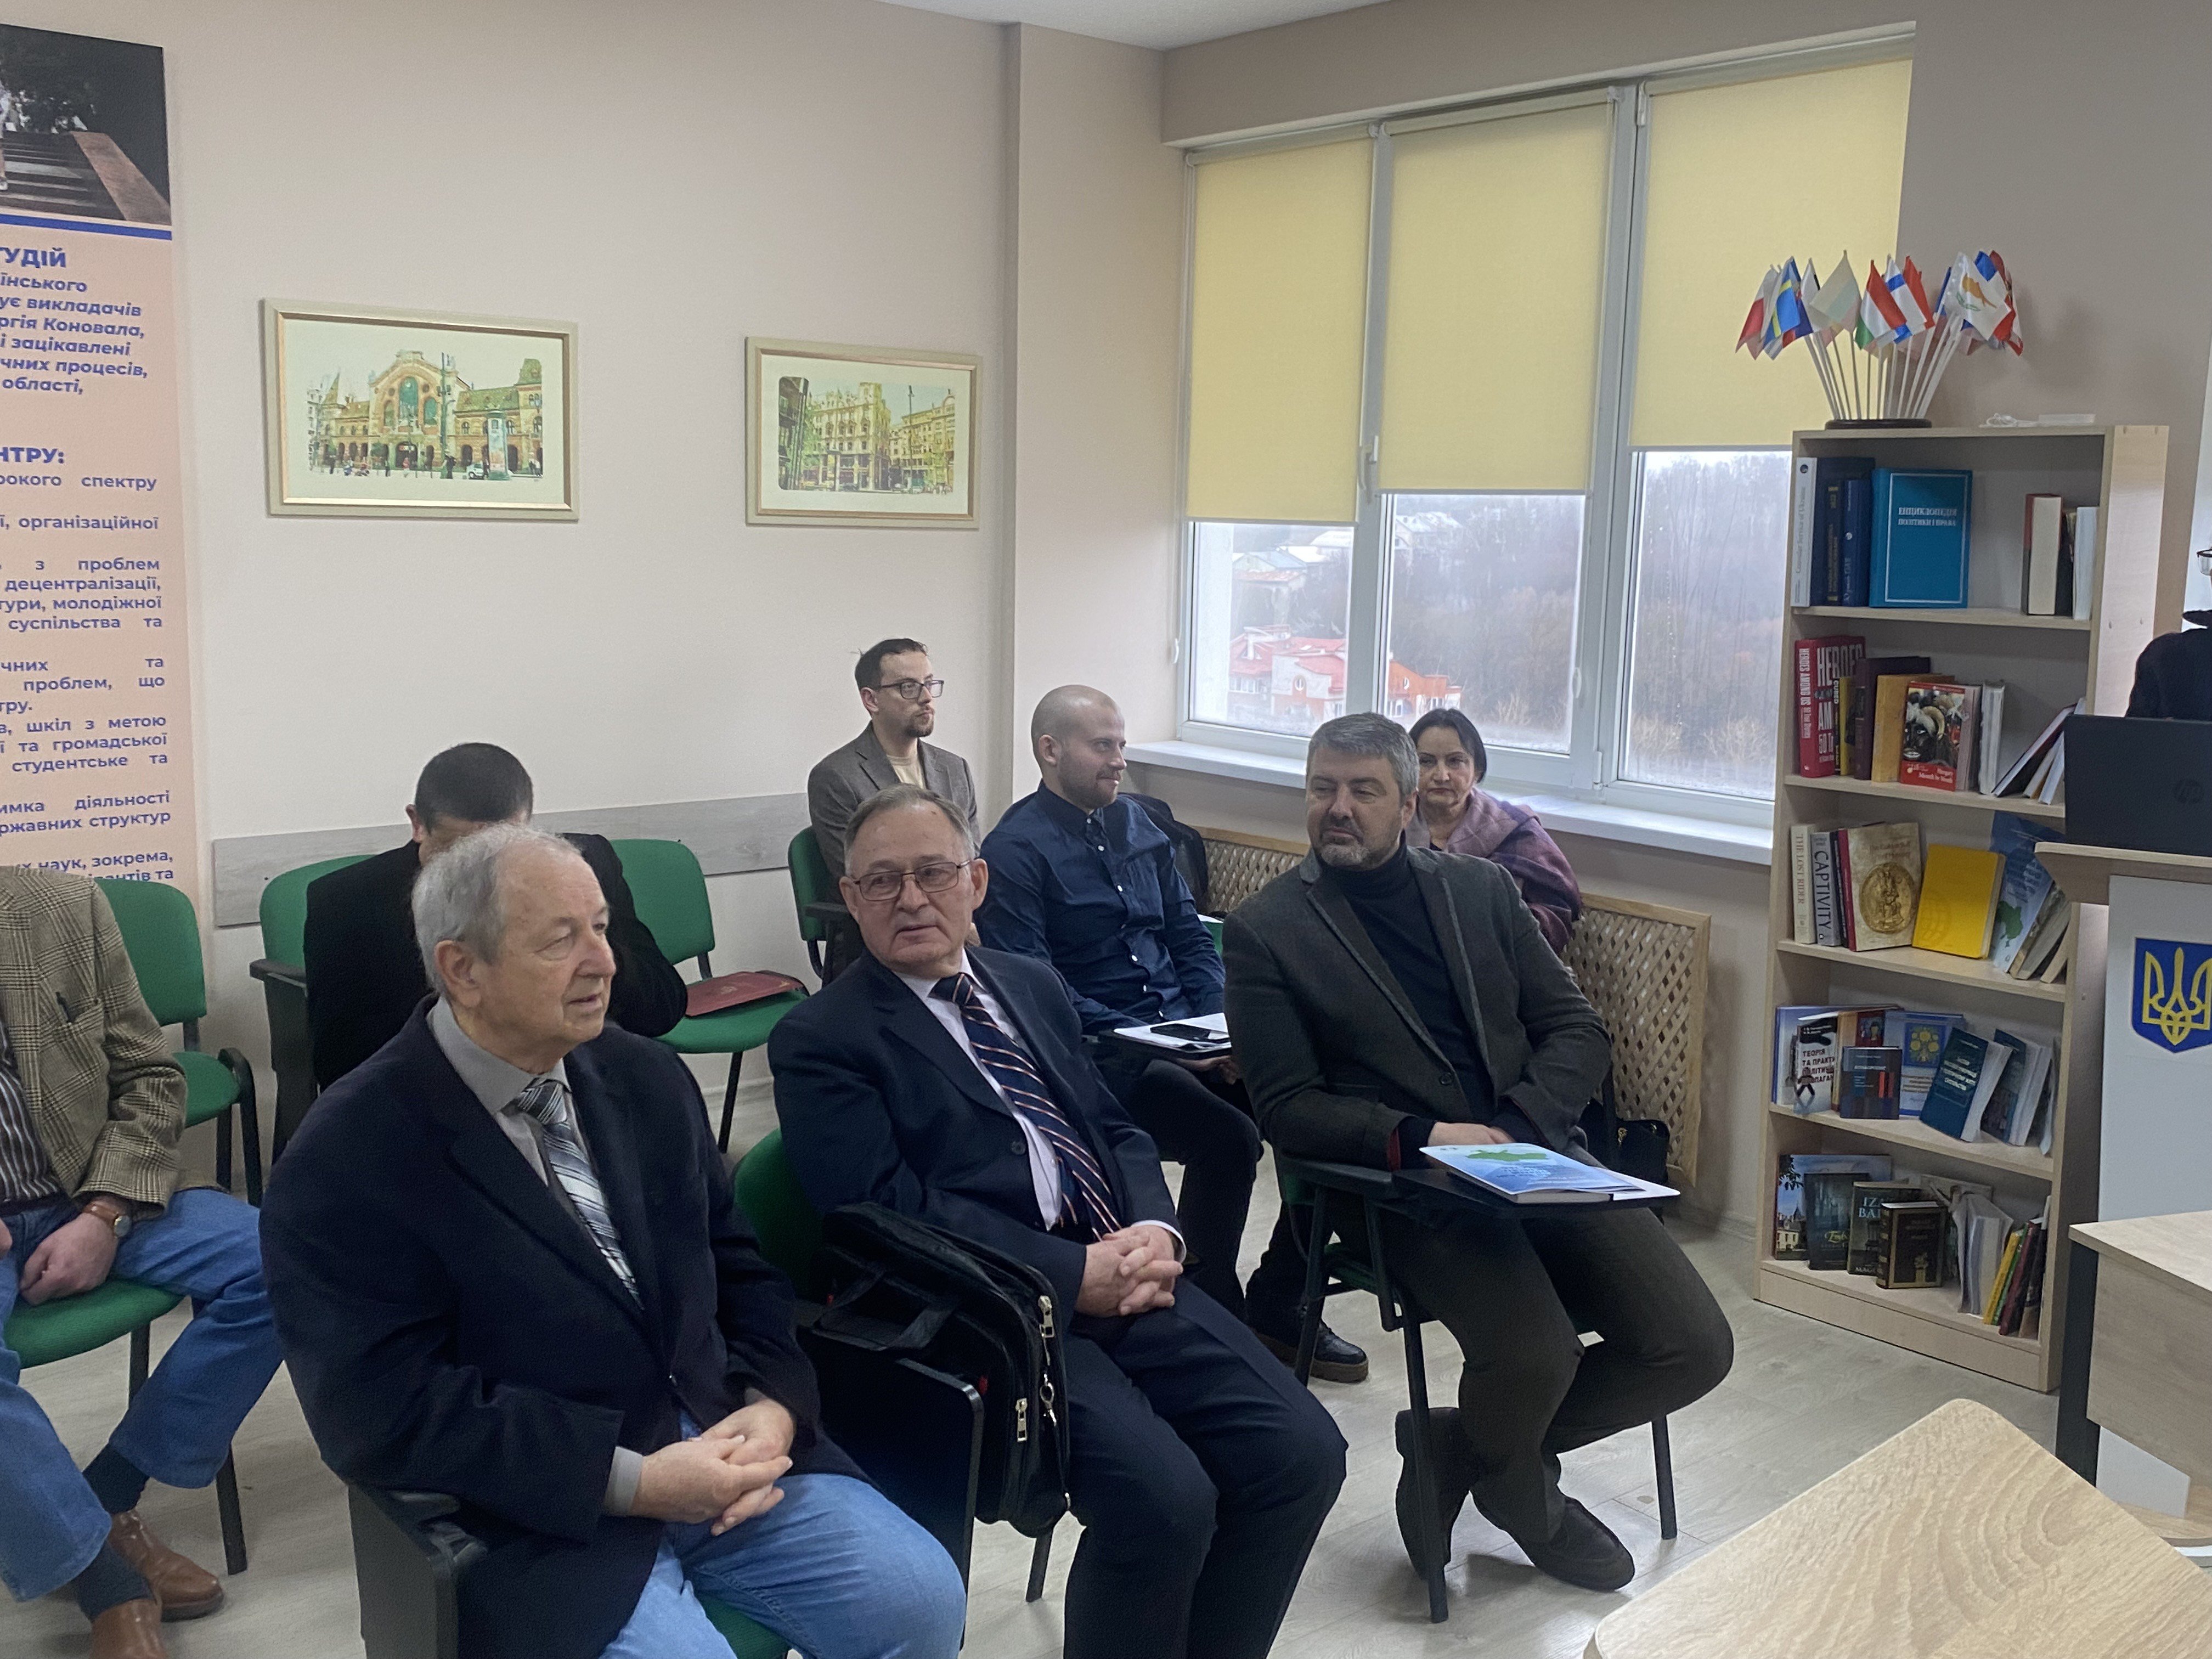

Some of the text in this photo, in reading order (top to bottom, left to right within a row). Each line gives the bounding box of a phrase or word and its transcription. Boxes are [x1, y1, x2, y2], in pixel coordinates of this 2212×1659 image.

[0, 272, 87, 292] їнського
[27, 298, 142, 316] викладачів
[43, 318, 144, 339] Коновала,
[11, 337, 131, 356] зацікавлені
[0, 359, 148, 378] чних процесів,
[2, 377, 83, 395] області,
[81, 477, 157, 491] спектру
[19, 515, 159, 531] організаційної
[36, 557, 160, 573] з проблем
[4, 576, 161, 592] децентралізації,
[53, 596, 161, 611] молодіжної
[8, 616, 162, 633] суспільства та
[1, 658, 163, 672] чних та
[1799, 648, 1810, 672] HEROES
[24, 676, 165, 693] проблем, що
[1799, 673, 1811, 696] AMONG
[1800, 696, 1812, 706] US
[27, 718, 71, 732] шкіл
[85, 720, 95, 730] з
[109, 717, 166, 728] метою
[18, 742, 38, 752] та
[53, 732, 167, 753] громадської
[12, 754, 167, 774] студентське та
[74, 790, 170, 810] діяльності
[89, 812, 171, 828] структур
[92, 852, 173, 867] зокрема,
[1796, 854, 1804, 875] LOST
[155, 869, 174, 879] та
[1797, 879, 1805, 904] RIDER
[1814, 851, 1832, 930] CAPTIVITY
[1803, 1048, 1825, 1057] ТЕОРІЯ
[1863, 1197, 1881, 1207] IZ
